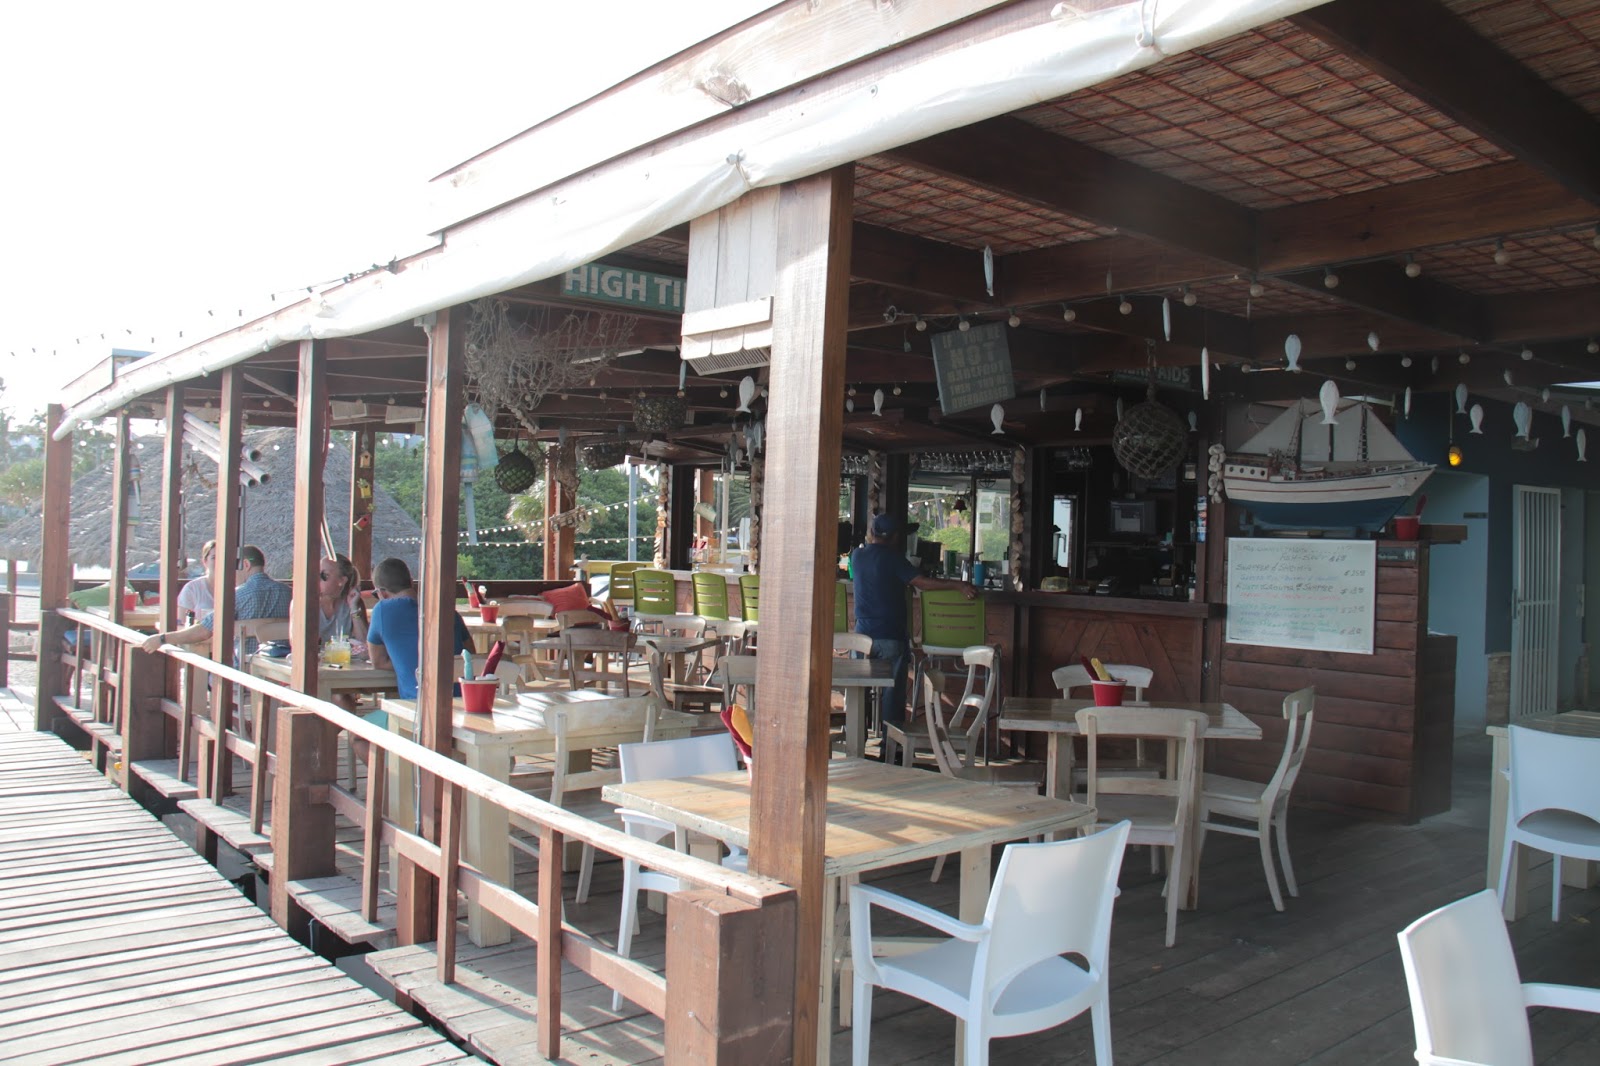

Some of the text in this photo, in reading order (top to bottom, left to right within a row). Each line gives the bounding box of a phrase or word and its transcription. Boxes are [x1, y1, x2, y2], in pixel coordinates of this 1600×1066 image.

[565, 265, 686, 308] HIGH TI
[950, 342, 995, 368] NOT
[947, 361, 1004, 382] BAREFOOT
